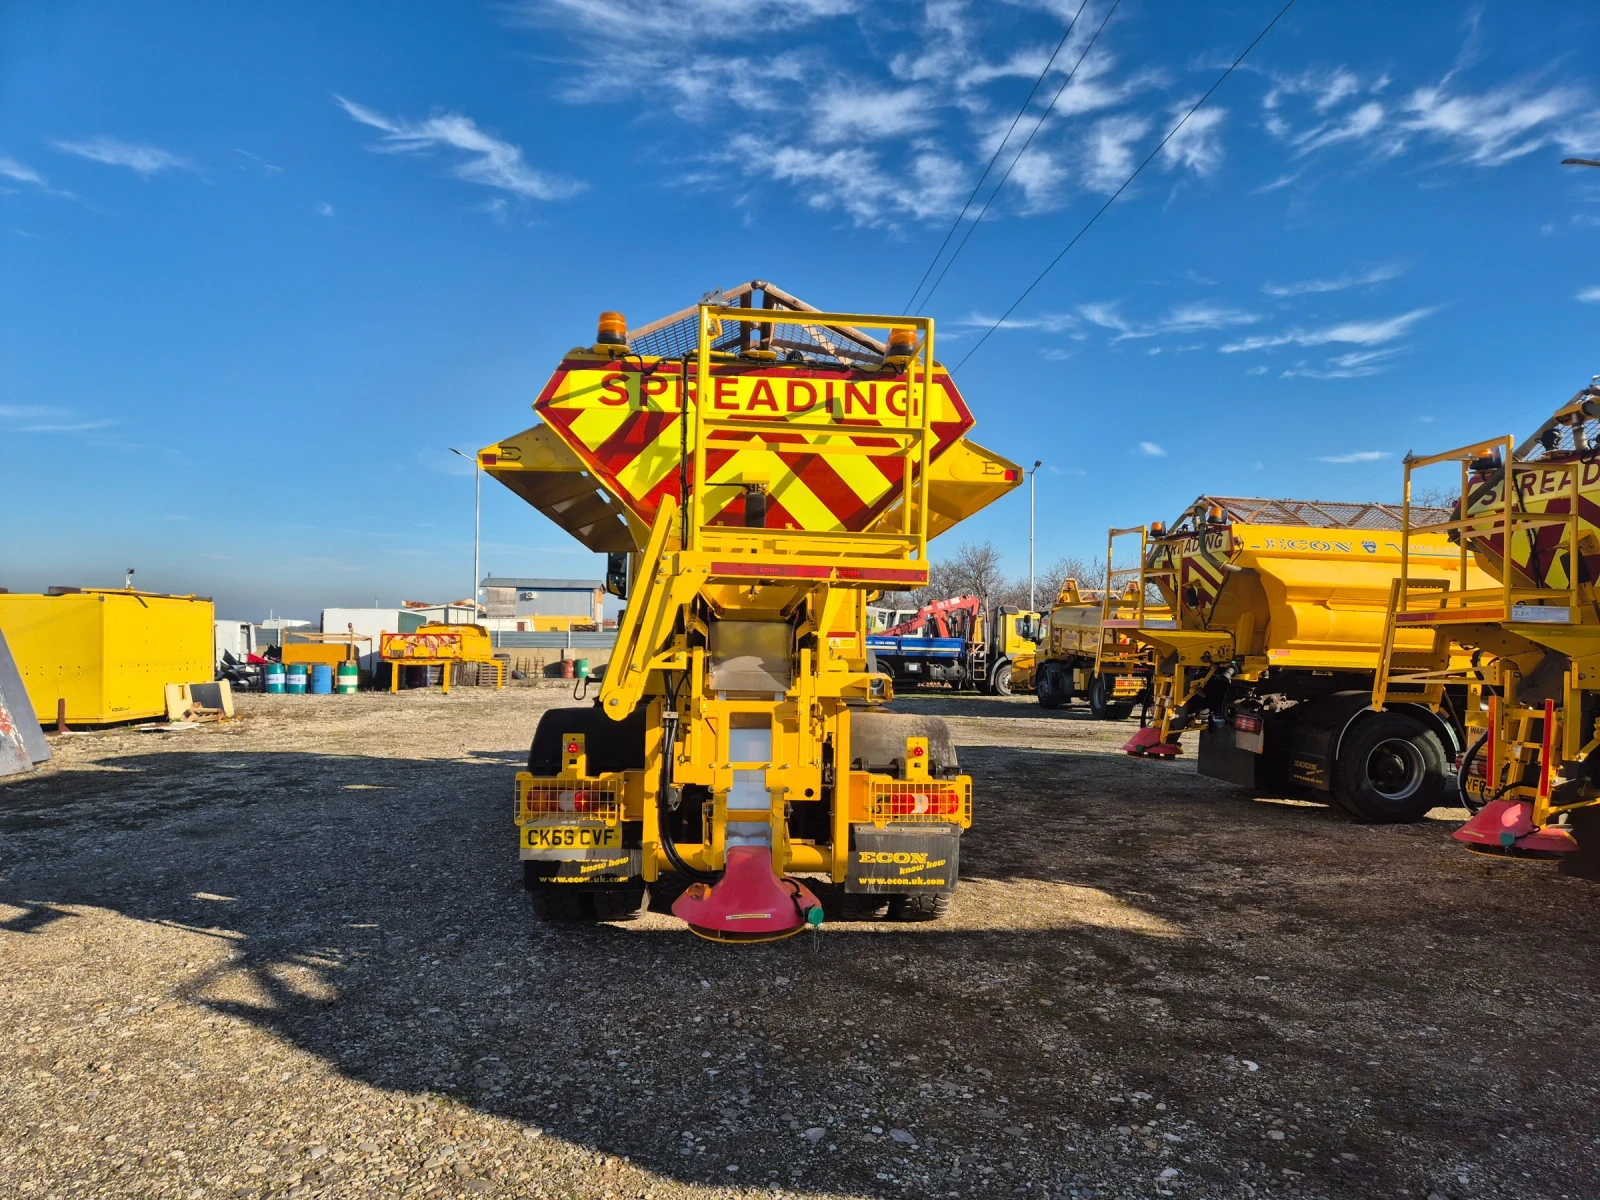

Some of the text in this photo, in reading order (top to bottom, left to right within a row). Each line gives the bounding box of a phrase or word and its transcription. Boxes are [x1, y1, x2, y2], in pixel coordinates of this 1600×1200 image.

[597, 373, 919, 416] SPREADING
[1263, 537, 1353, 553] ECON
[580, 829, 614, 846] CVF
[580, 856, 629, 873] know how
[859, 851, 928, 864] ECON
[899, 859, 946, 875] know how
[858, 876, 945, 885] www.econ.uk.com
